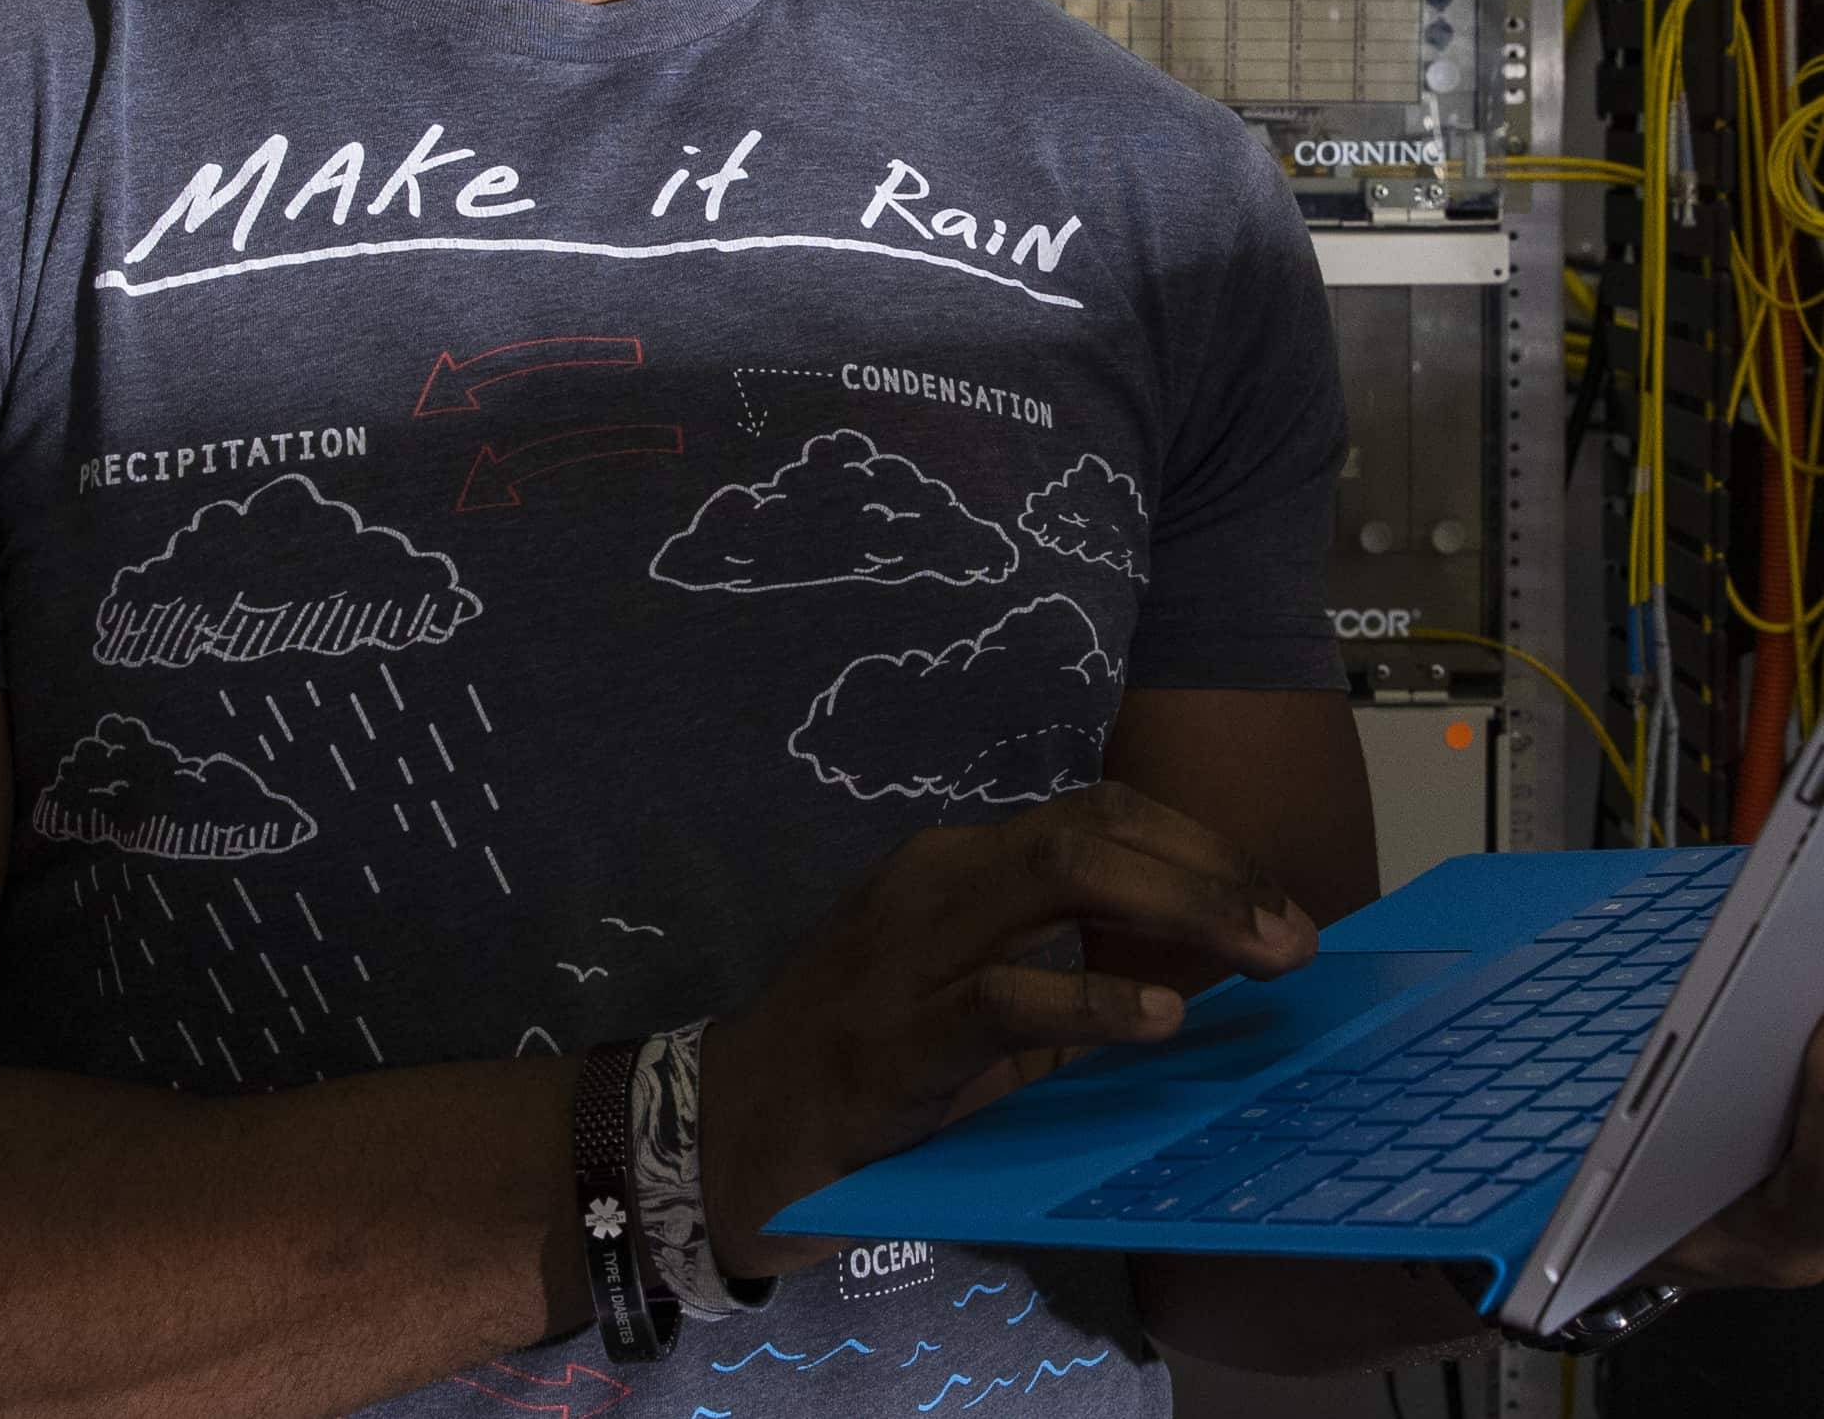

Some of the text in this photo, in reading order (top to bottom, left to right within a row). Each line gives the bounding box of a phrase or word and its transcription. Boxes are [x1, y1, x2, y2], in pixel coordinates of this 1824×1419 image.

[651, 128, 764, 223] it
[1293, 139, 1445, 166] CORNING
[840, 361, 1054, 430] CONDENSATION
[79, 425, 368, 494] PRECIPITATION
[601, 1247, 623, 1285] TYPE
[849, 1240, 928, 1279] OCEAN
[609, 1292, 636, 1346] DIABETES
